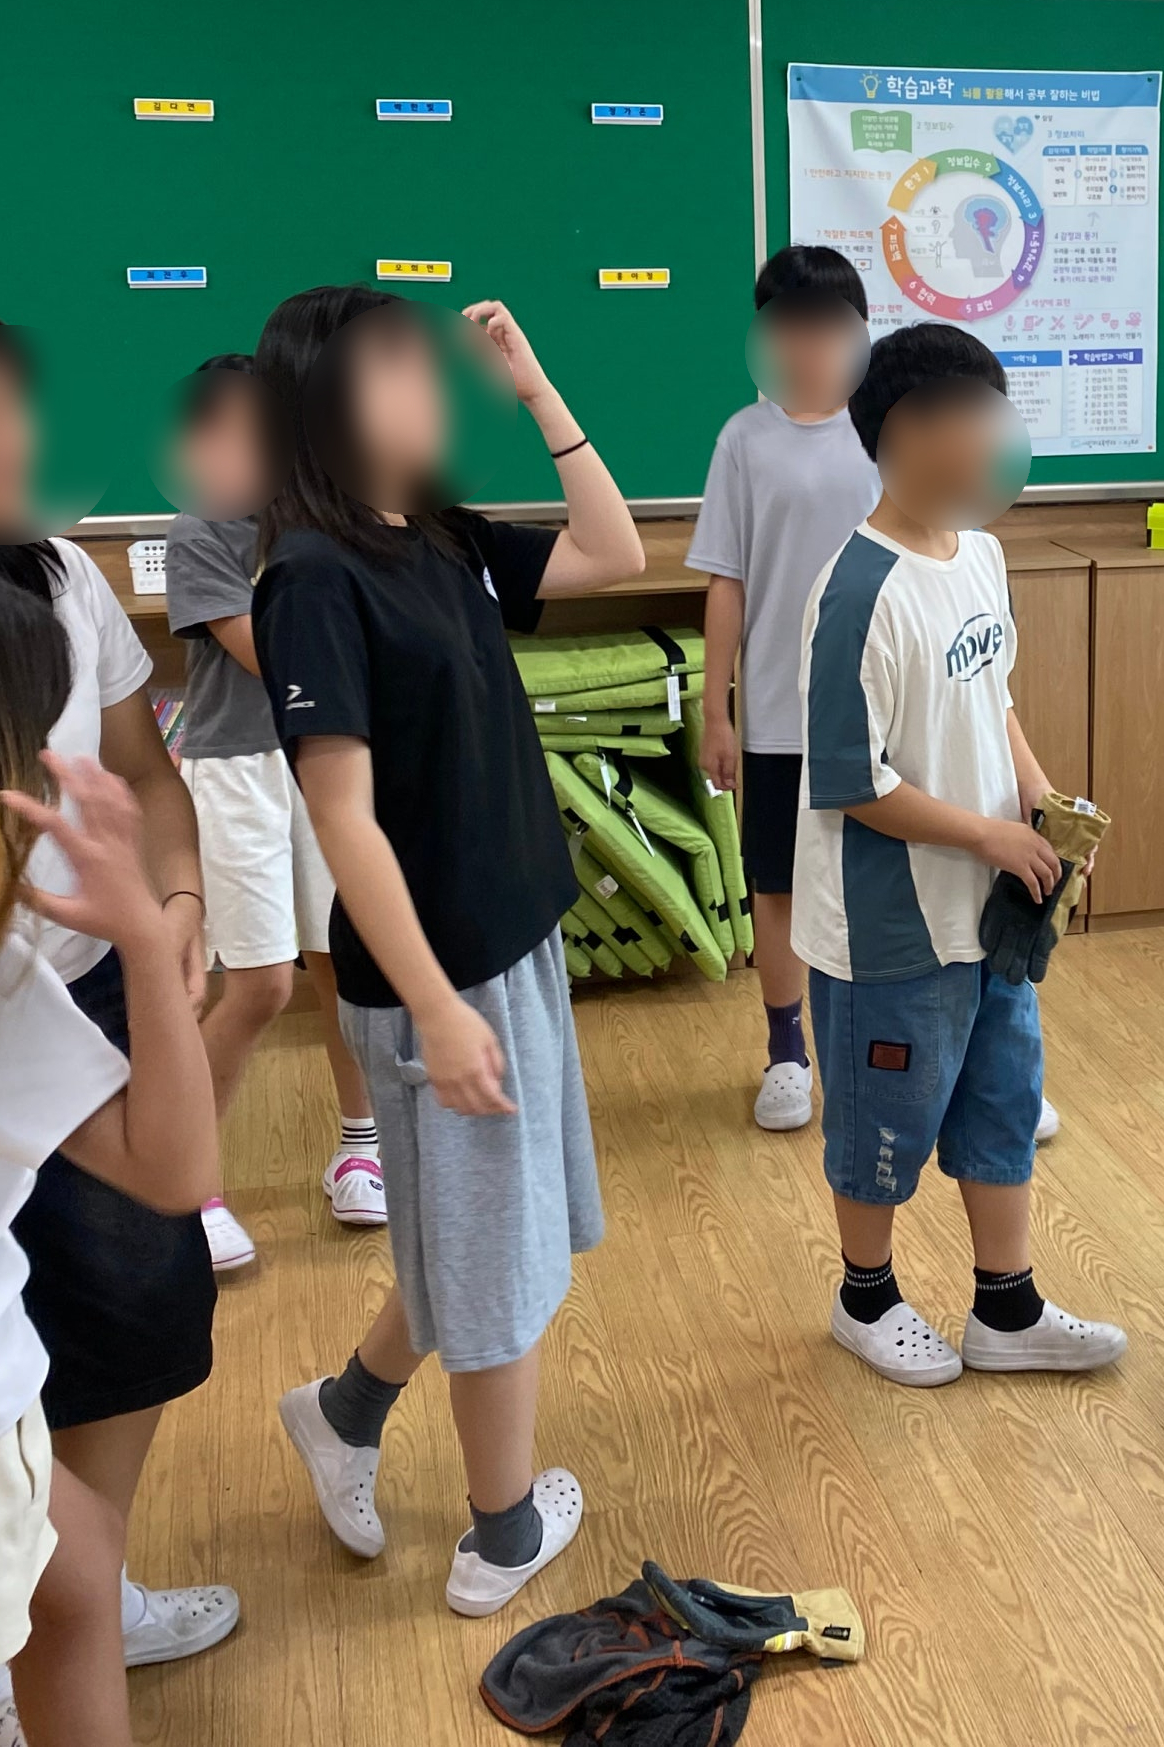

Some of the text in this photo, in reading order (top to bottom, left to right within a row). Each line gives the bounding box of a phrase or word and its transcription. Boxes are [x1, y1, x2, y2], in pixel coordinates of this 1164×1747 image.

[886, 74, 955, 100] 학습과학
[1026, 89, 1047, 101] 공부
[1050, 89, 1079, 102] 잘하는
[1081, 89, 1101, 102] 비법
[946, 156, 981, 169] 정보입수
[923, 166, 930, 175] 1
[1007, 174, 1037, 219] 정보처리 3
[849, 230, 874, 239] 피드백
[1060, 232, 1082, 240] 감정과
[1084, 232, 1099, 240] 동기
[889, 234, 903, 262] 피드백
[909, 281, 937, 306] 6 협력
[887, 304, 903, 313] 협력
[965, 299, 993, 313] 5 표현
[1056, 299, 1071, 307] 표현
[1011, 354, 1038, 365] 기억기술
[945, 623, 1003, 678] move
